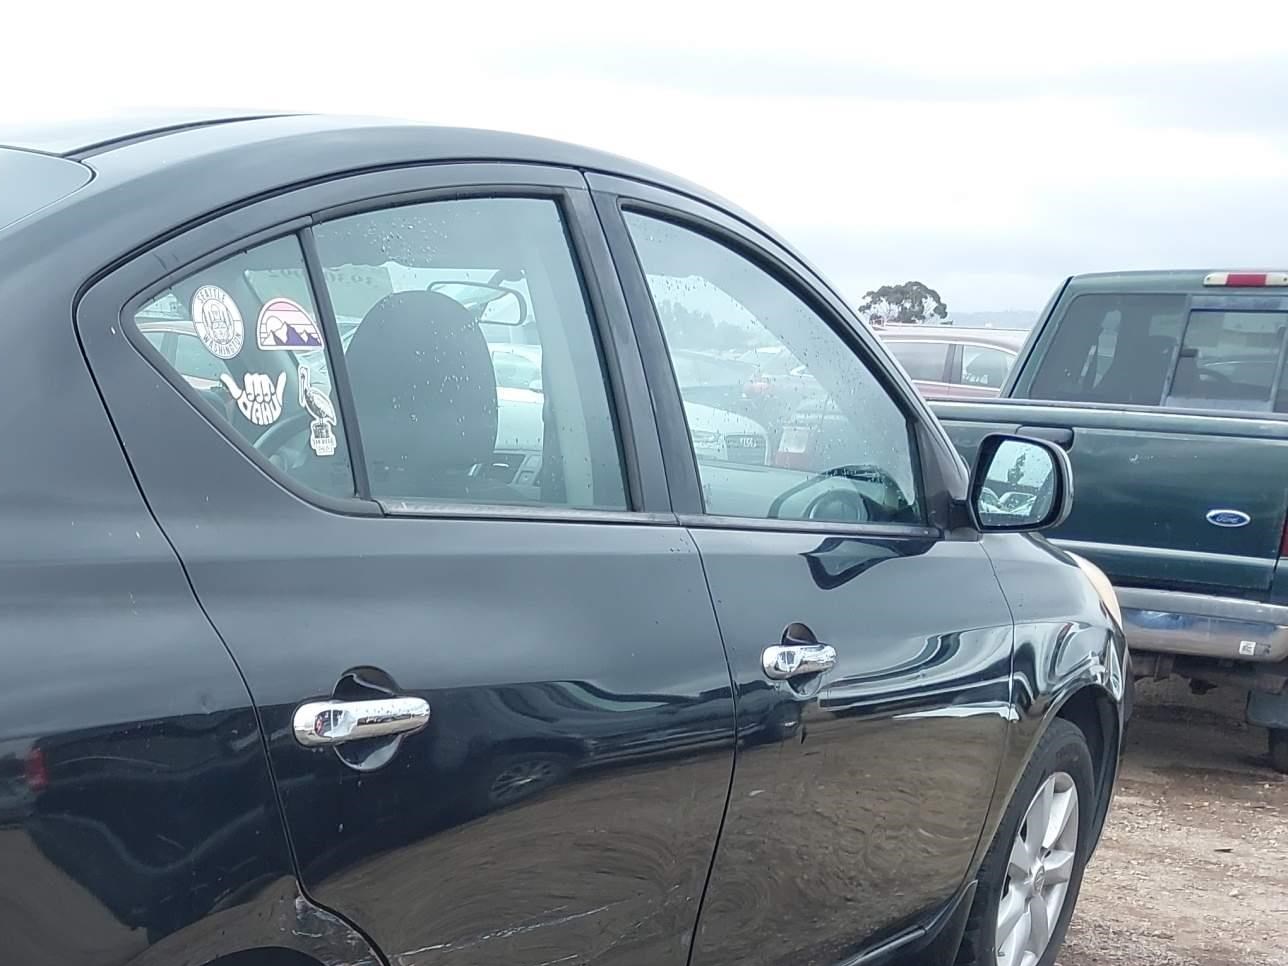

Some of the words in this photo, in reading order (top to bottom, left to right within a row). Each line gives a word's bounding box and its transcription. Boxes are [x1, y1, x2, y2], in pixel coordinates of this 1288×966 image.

[198, 287, 226, 304] SEATTLE
[203, 332, 242, 356] WASHINGTON
[237, 393, 283, 426] OAHU
